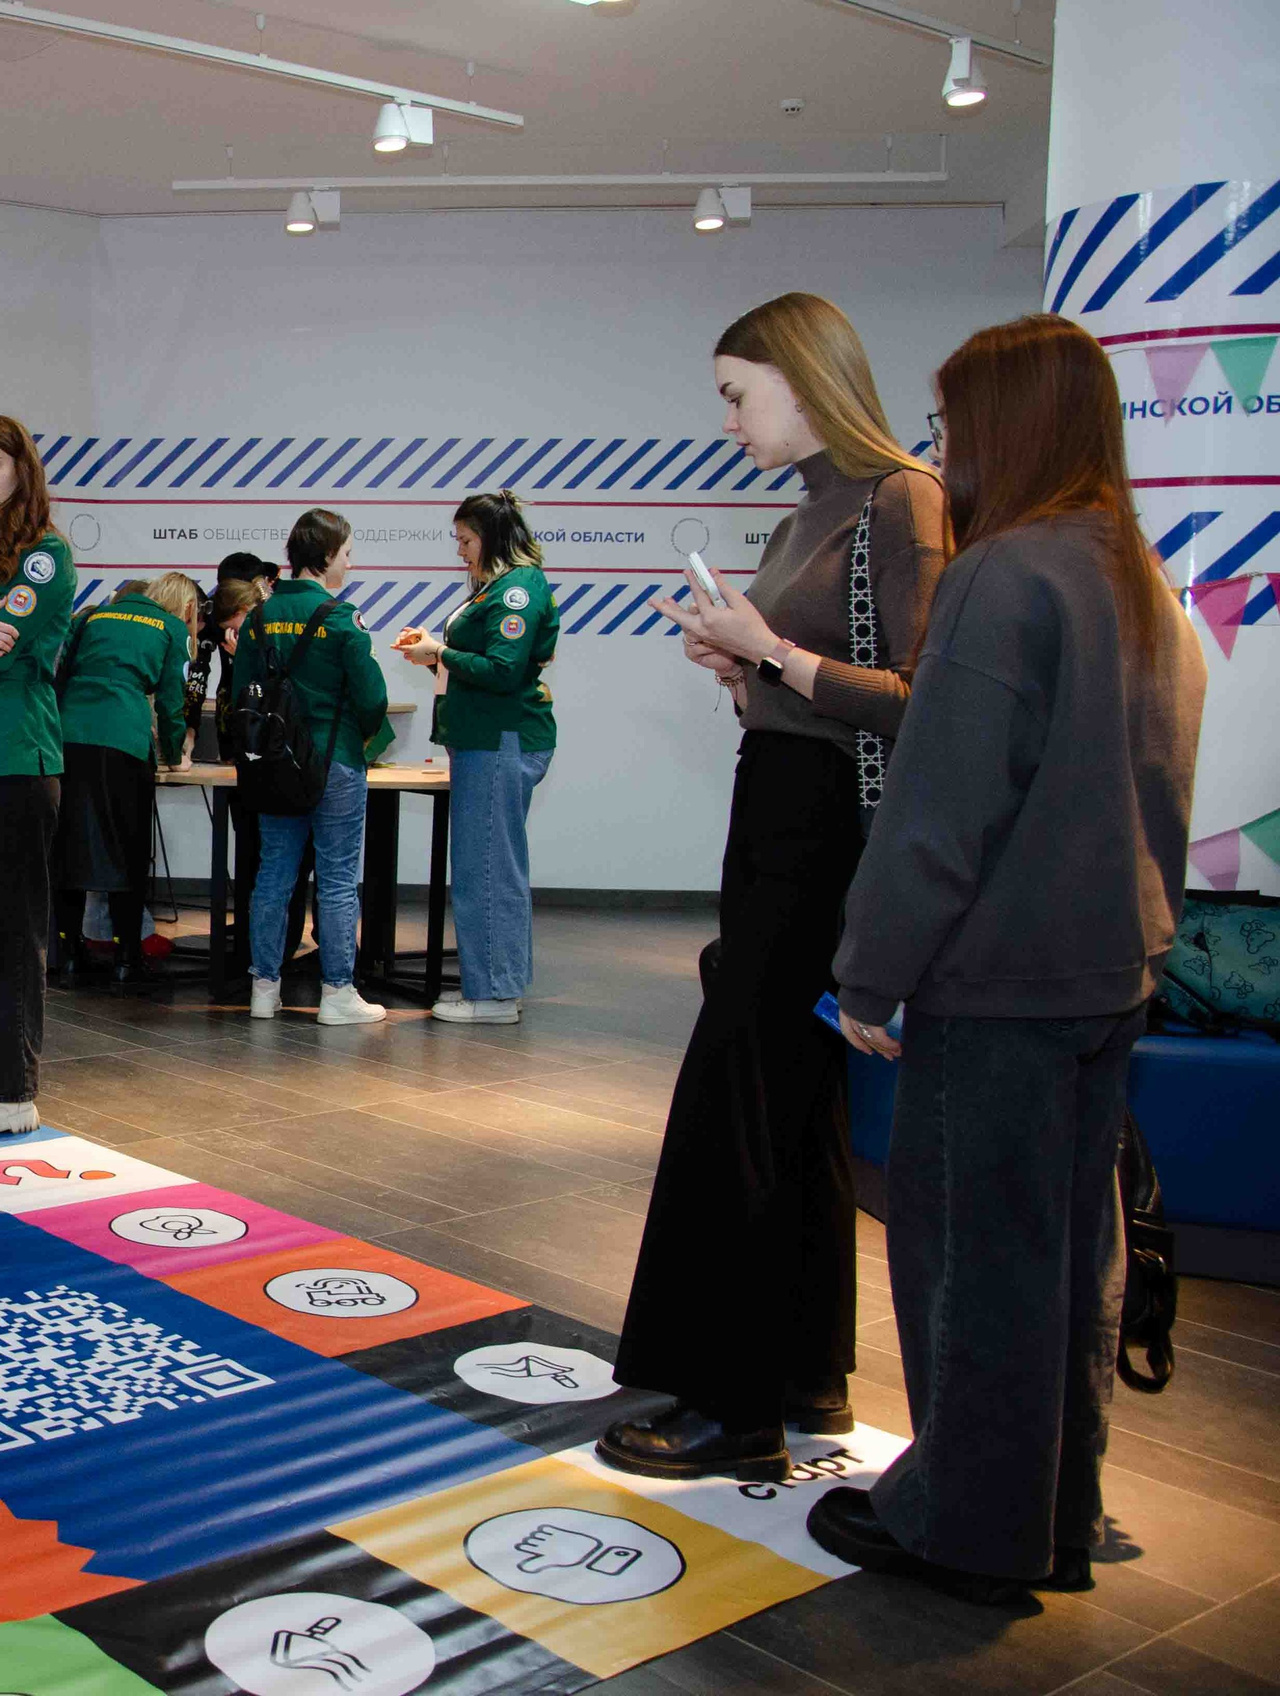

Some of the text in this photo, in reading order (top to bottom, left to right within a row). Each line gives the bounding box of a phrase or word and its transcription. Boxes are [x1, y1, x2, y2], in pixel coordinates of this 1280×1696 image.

[153, 528, 198, 540] ШТАБ
[203, 528, 289, 543] ОБЩЕСТВЕ
[353, 528, 443, 543] ОДДЕРЖКИ
[571, 532, 645, 543] ОБЛАСТИ
[745, 533, 770, 544] ШТ
